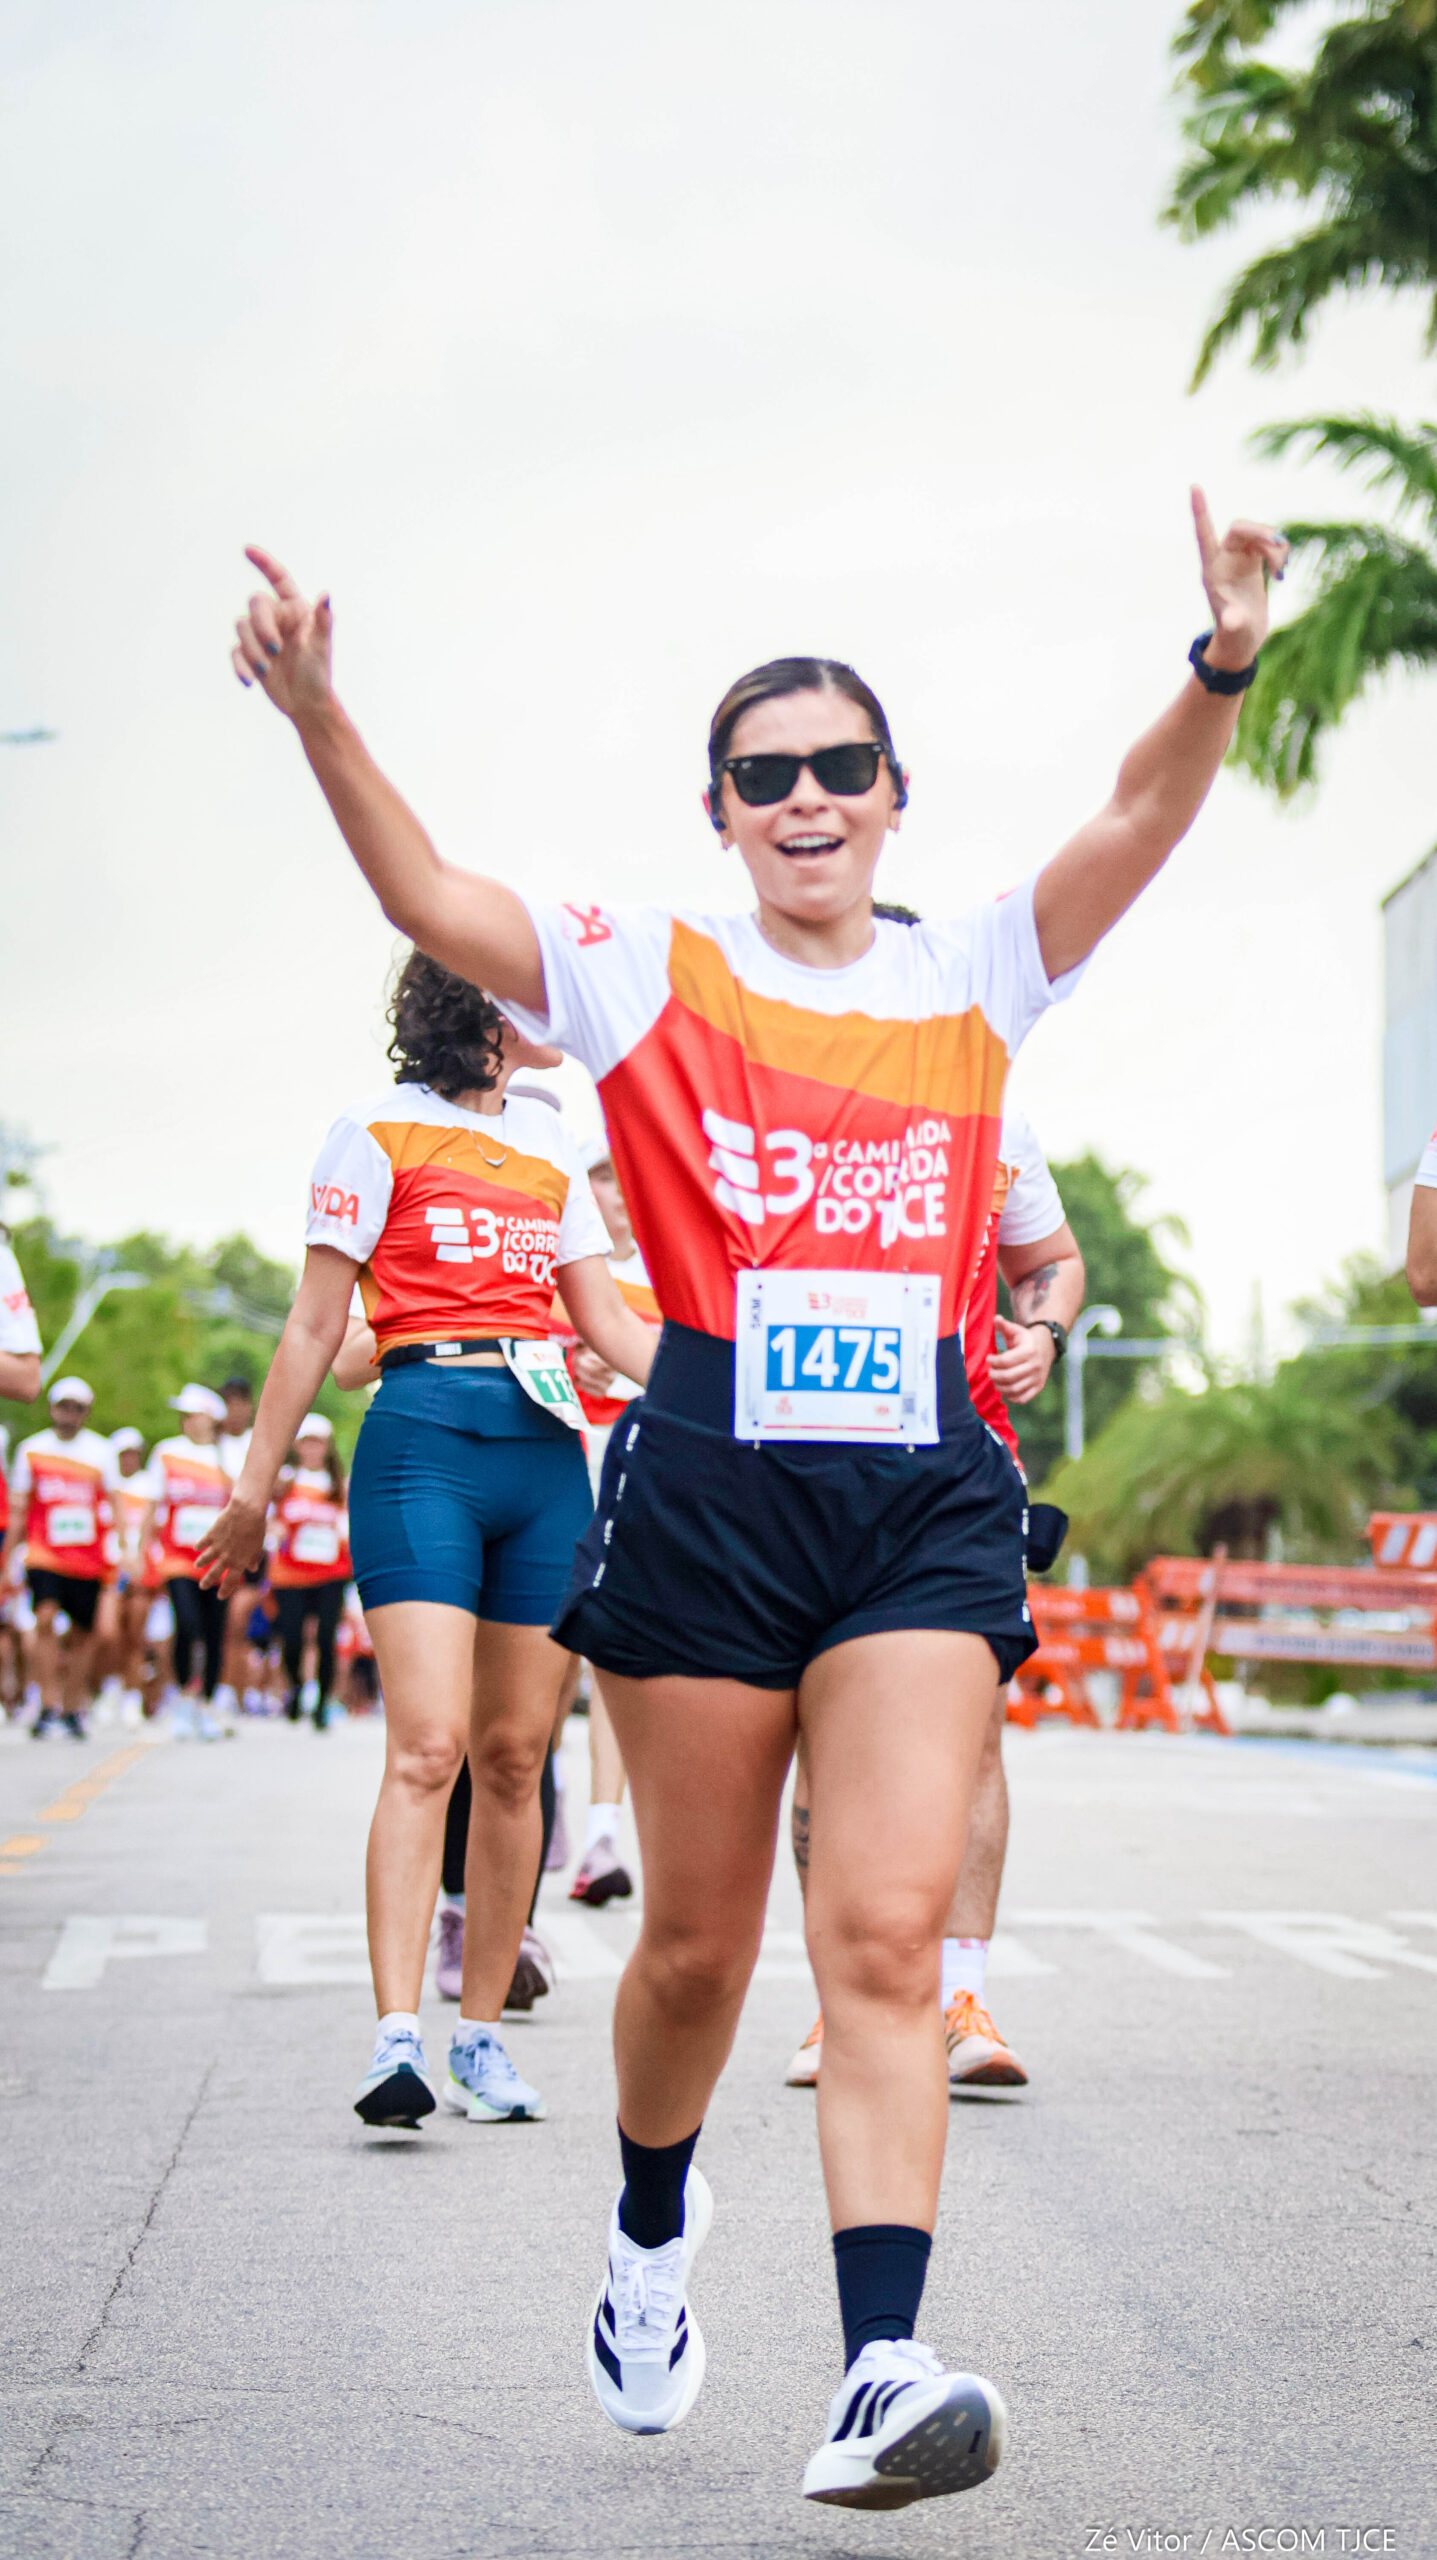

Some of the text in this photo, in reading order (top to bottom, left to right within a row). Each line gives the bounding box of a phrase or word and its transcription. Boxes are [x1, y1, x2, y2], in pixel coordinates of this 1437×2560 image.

[832, 1118, 952, 1165] CAMIDA
[815, 1197, 872, 1234] DO
[502, 1251, 559, 1286] DO TJC
[769, 1326, 901, 1390] 1475
